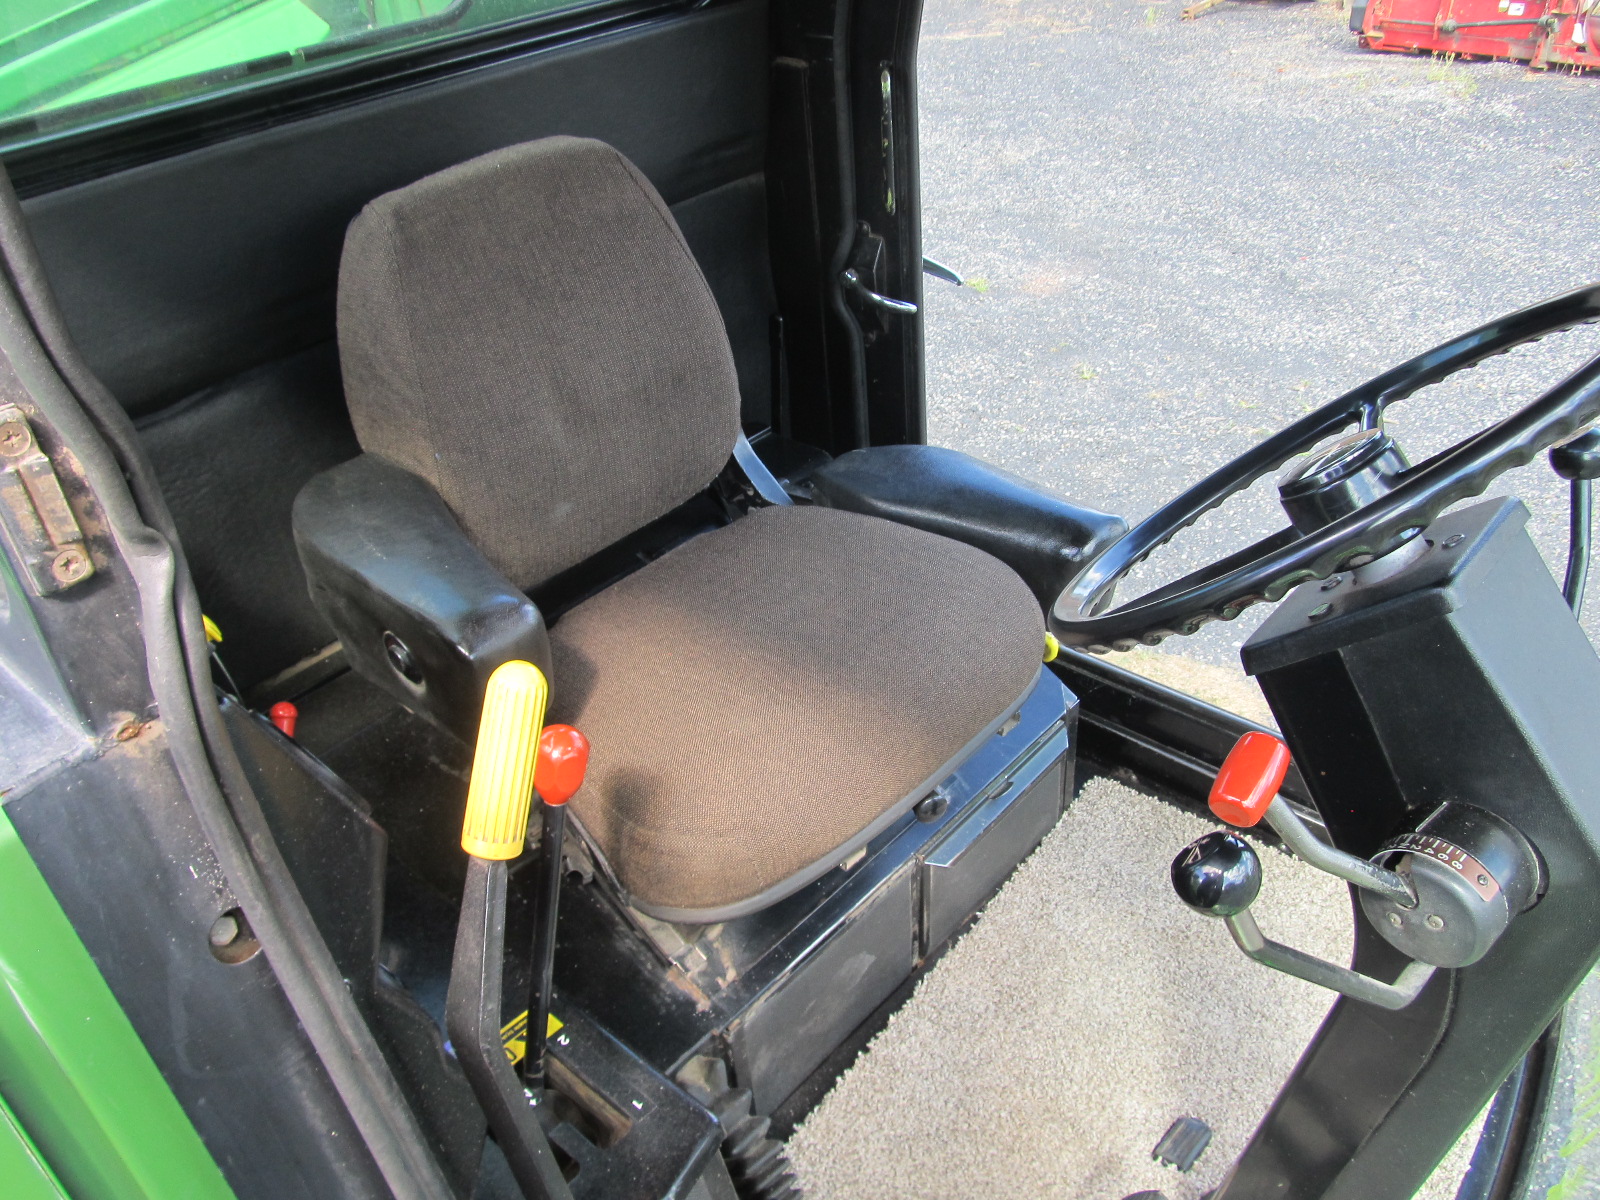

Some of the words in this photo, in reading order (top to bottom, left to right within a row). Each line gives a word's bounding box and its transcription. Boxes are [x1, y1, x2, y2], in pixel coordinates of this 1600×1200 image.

[1437, 853, 1449, 861] 6
[1451, 860, 1463, 869] 8
[557, 1034, 570, 1045] 2
[632, 1099, 643, 1110] 1
